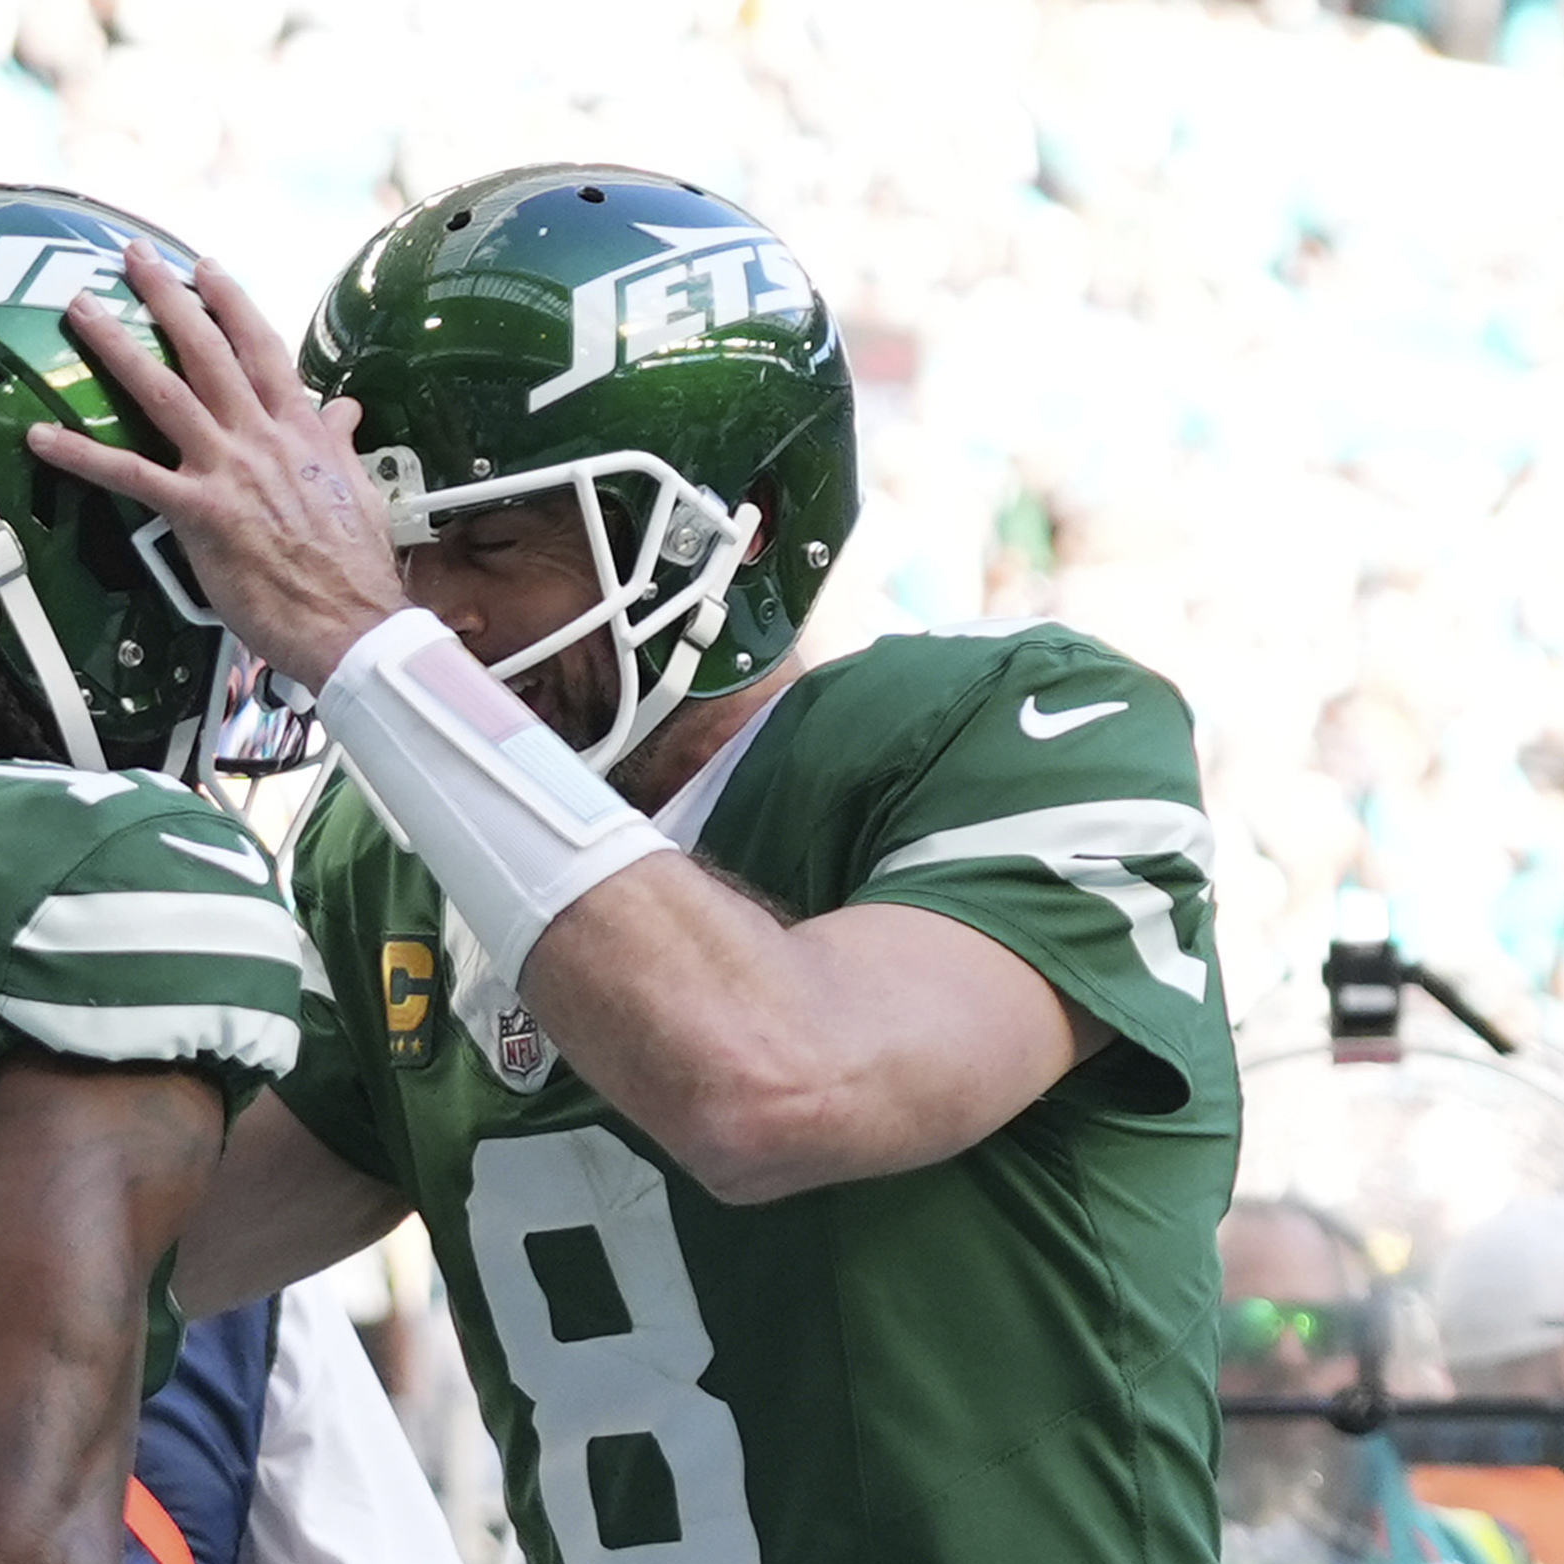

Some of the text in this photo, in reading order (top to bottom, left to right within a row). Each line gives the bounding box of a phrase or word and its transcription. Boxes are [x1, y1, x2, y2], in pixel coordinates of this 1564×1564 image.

[528, 222, 815, 414] JETS
[381, 941, 435, 1032] C
[503, 1035, 539, 1067] NFL
